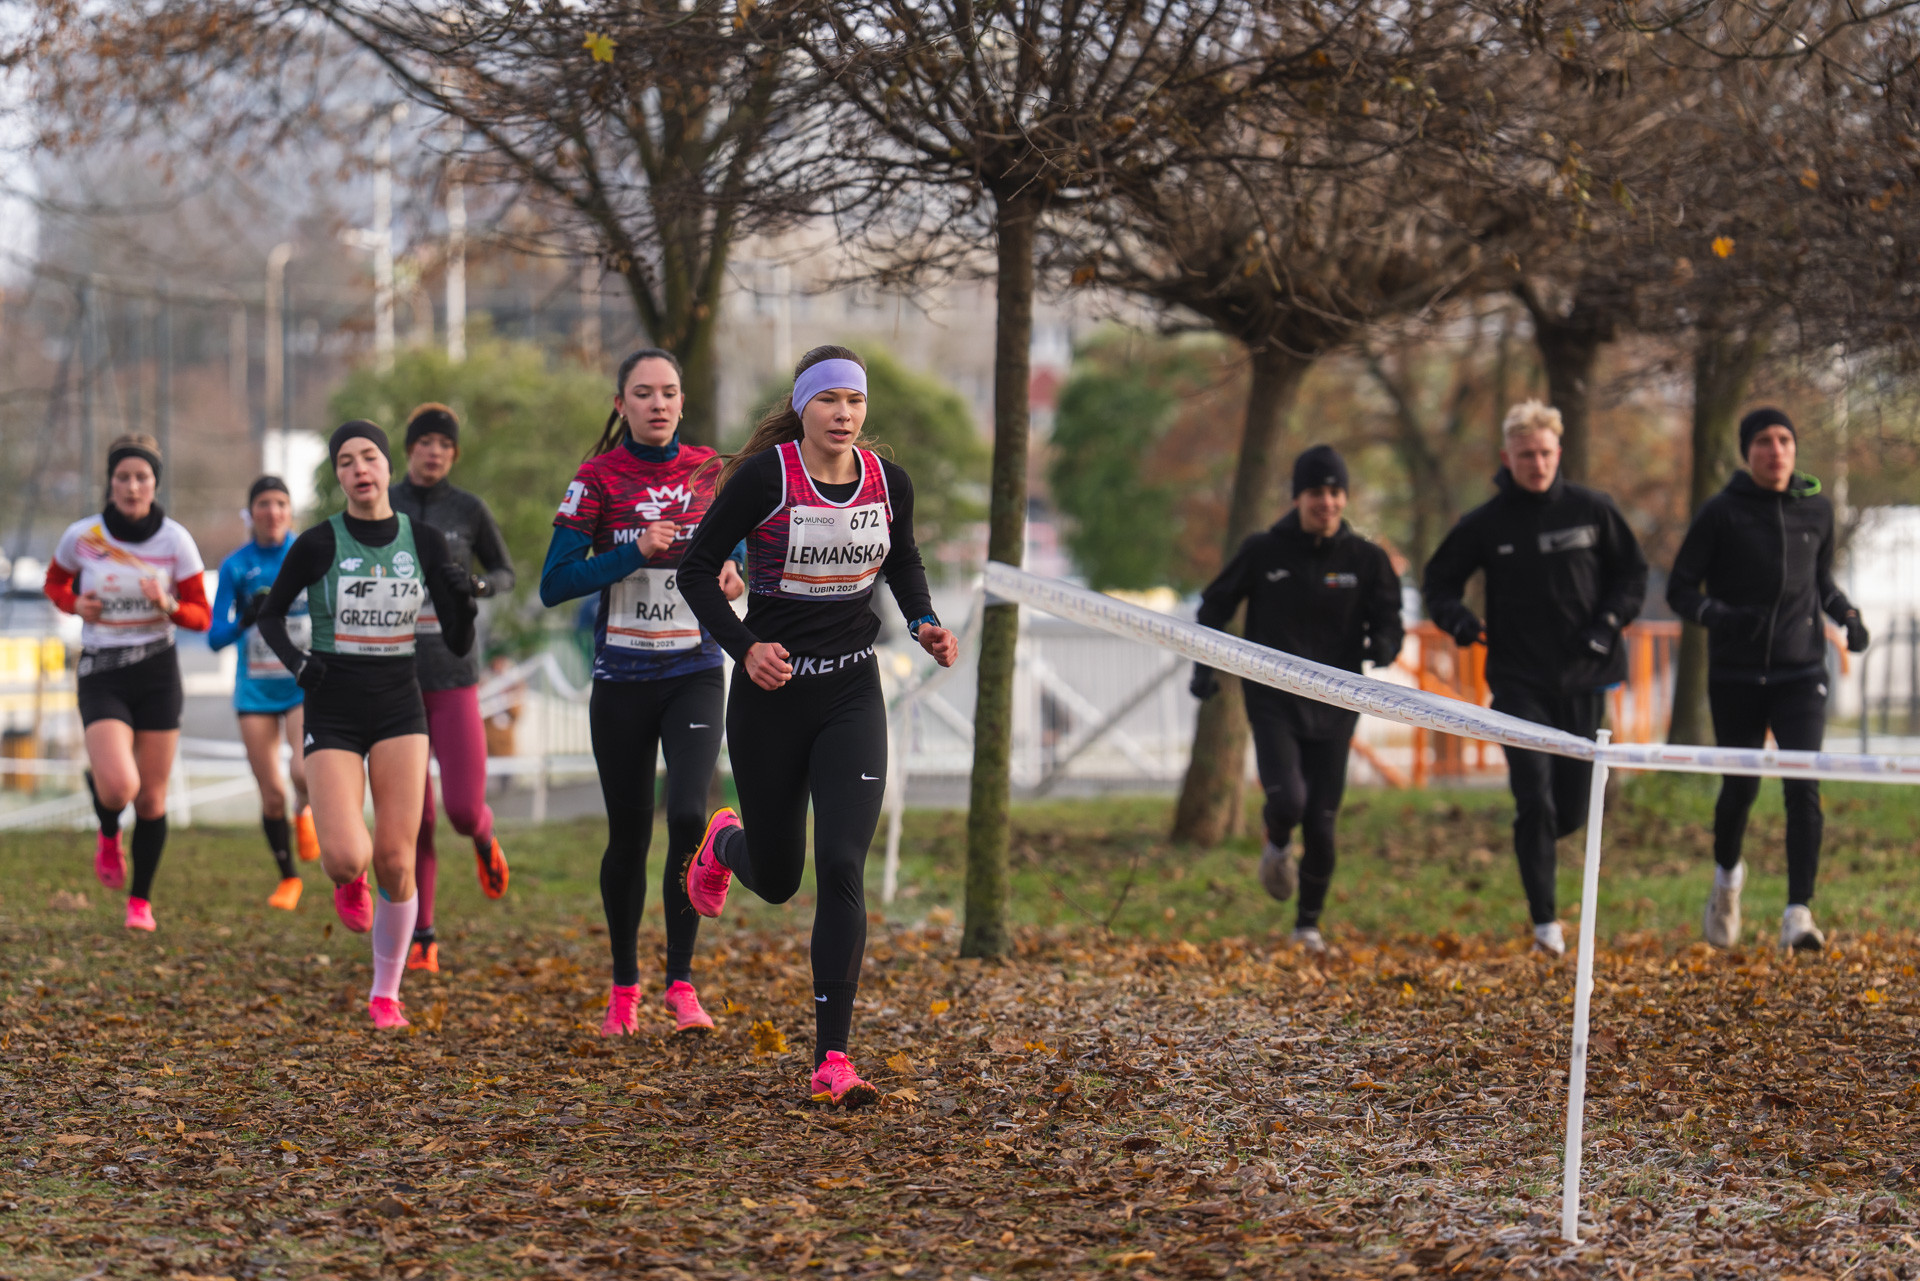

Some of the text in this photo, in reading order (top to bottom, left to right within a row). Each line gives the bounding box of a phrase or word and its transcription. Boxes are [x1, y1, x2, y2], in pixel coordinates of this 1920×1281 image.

[804, 517, 835, 525] MUNDO
[849, 509, 880, 531] 672
[789, 541, 885, 565] LEMAŃSKA
[338, 557, 364, 572] 4F
[344, 581, 378, 598] 4F
[390, 582, 418, 598] 174
[809, 583, 858, 594] LUBIN 2025
[340, 609, 418, 627] GRZELCZAK
[636, 601, 676, 621] RAK
[631, 639, 676, 648] LUBIN 2025
[787, 656, 834, 676] IKE
